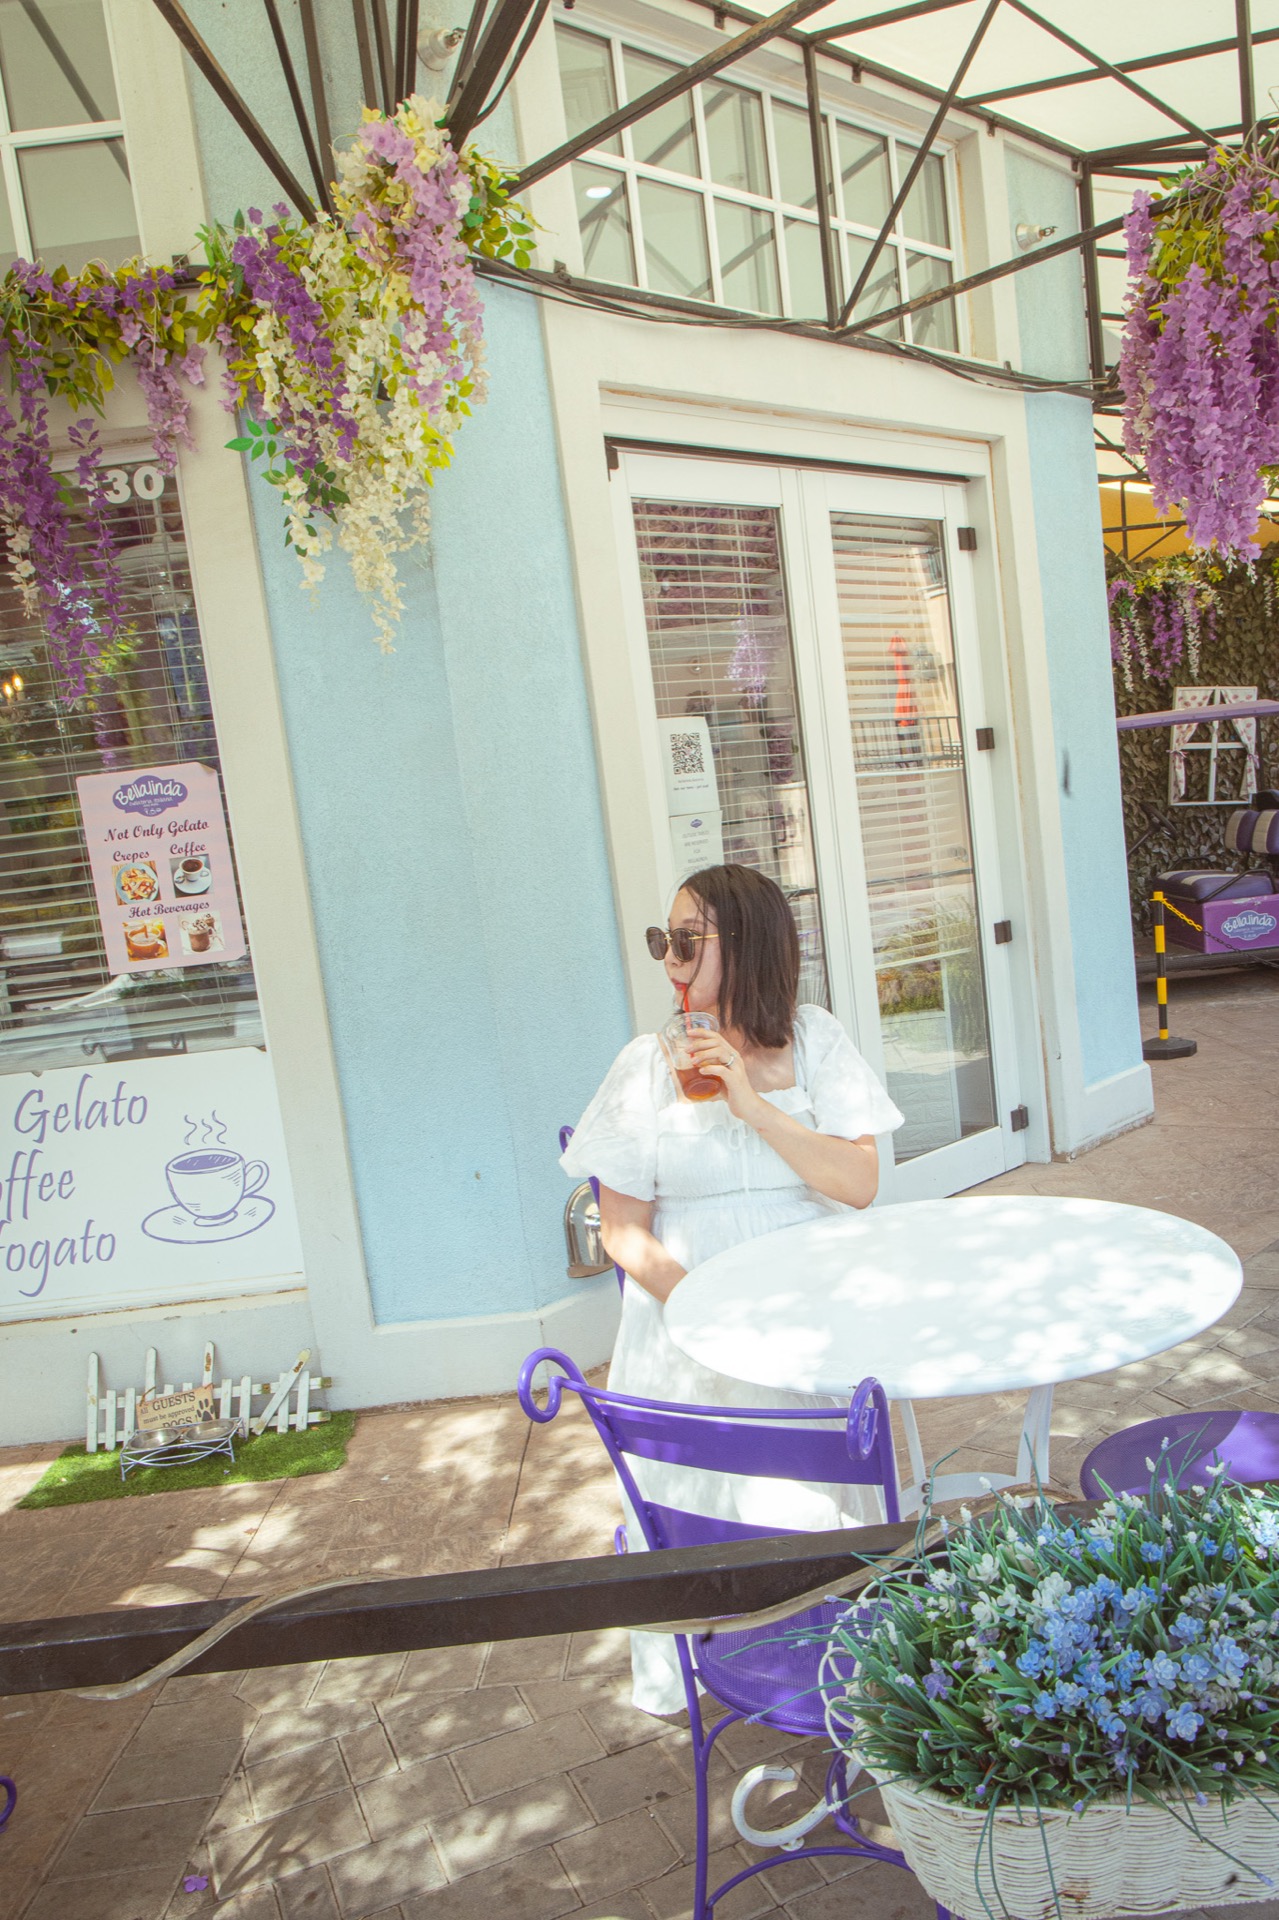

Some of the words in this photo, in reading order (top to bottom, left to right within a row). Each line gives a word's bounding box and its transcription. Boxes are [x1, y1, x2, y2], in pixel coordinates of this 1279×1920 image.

[115, 780, 183, 805] Bellalinda
[104, 828, 129, 842] Not
[133, 823, 165, 839] Only
[168, 819, 210, 837] Gelato
[112, 850, 150, 863] Crepes
[170, 841, 206, 856] Coffee
[128, 906, 152, 919] Hot
[153, 901, 210, 915] Beverages
[1224, 915, 1273, 932] Bellalinda
[14, 1073, 148, 1144] Gelato
[0, 1148, 76, 1222] ffee
[152, 1391, 196, 1411] GUESTS
[143, 1416, 159, 1424] must
[168, 1405, 195, 1419] approved
